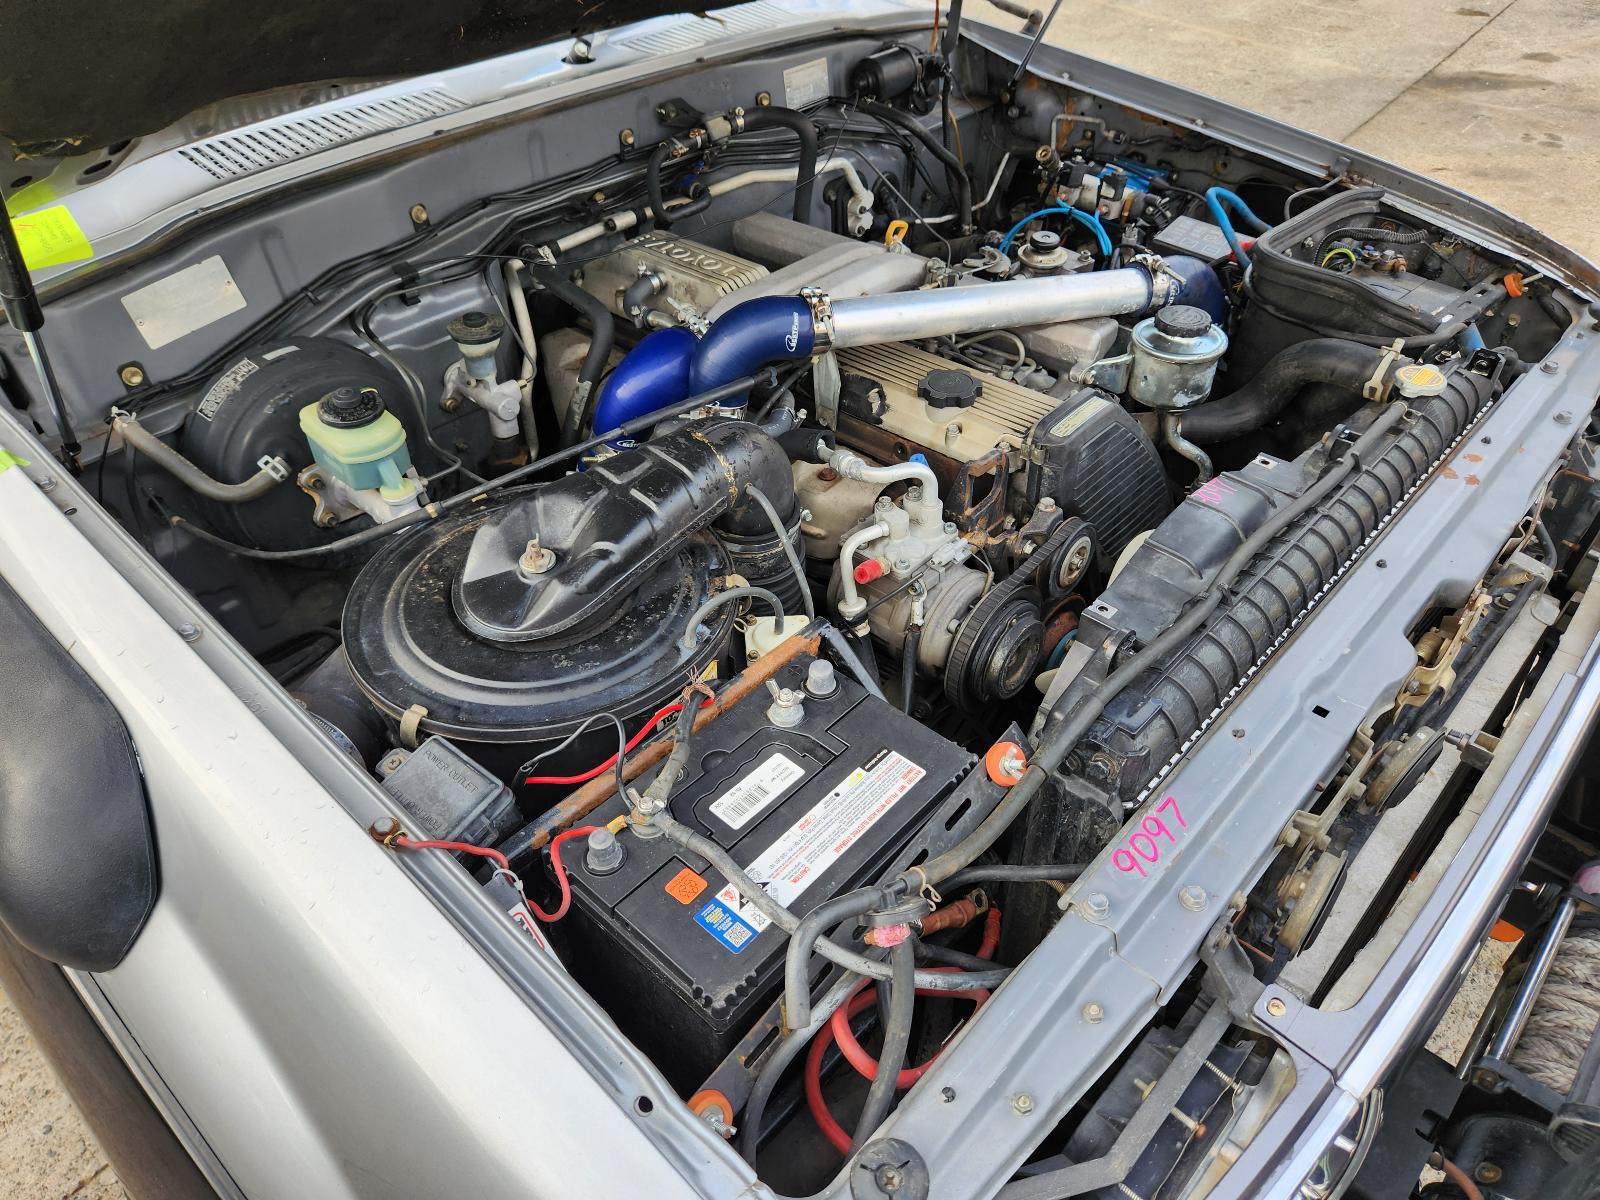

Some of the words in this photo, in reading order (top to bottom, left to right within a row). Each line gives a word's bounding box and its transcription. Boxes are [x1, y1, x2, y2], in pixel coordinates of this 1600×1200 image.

[425, 750, 449, 771] POWER
[448, 769, 479, 794] OUTLET
[848, 818, 870, 838] ELECTRIC
[1113, 796, 1189, 877] 9097
[832, 834, 854, 854] STORAGE
[788, 864, 811, 886] CAUTION
